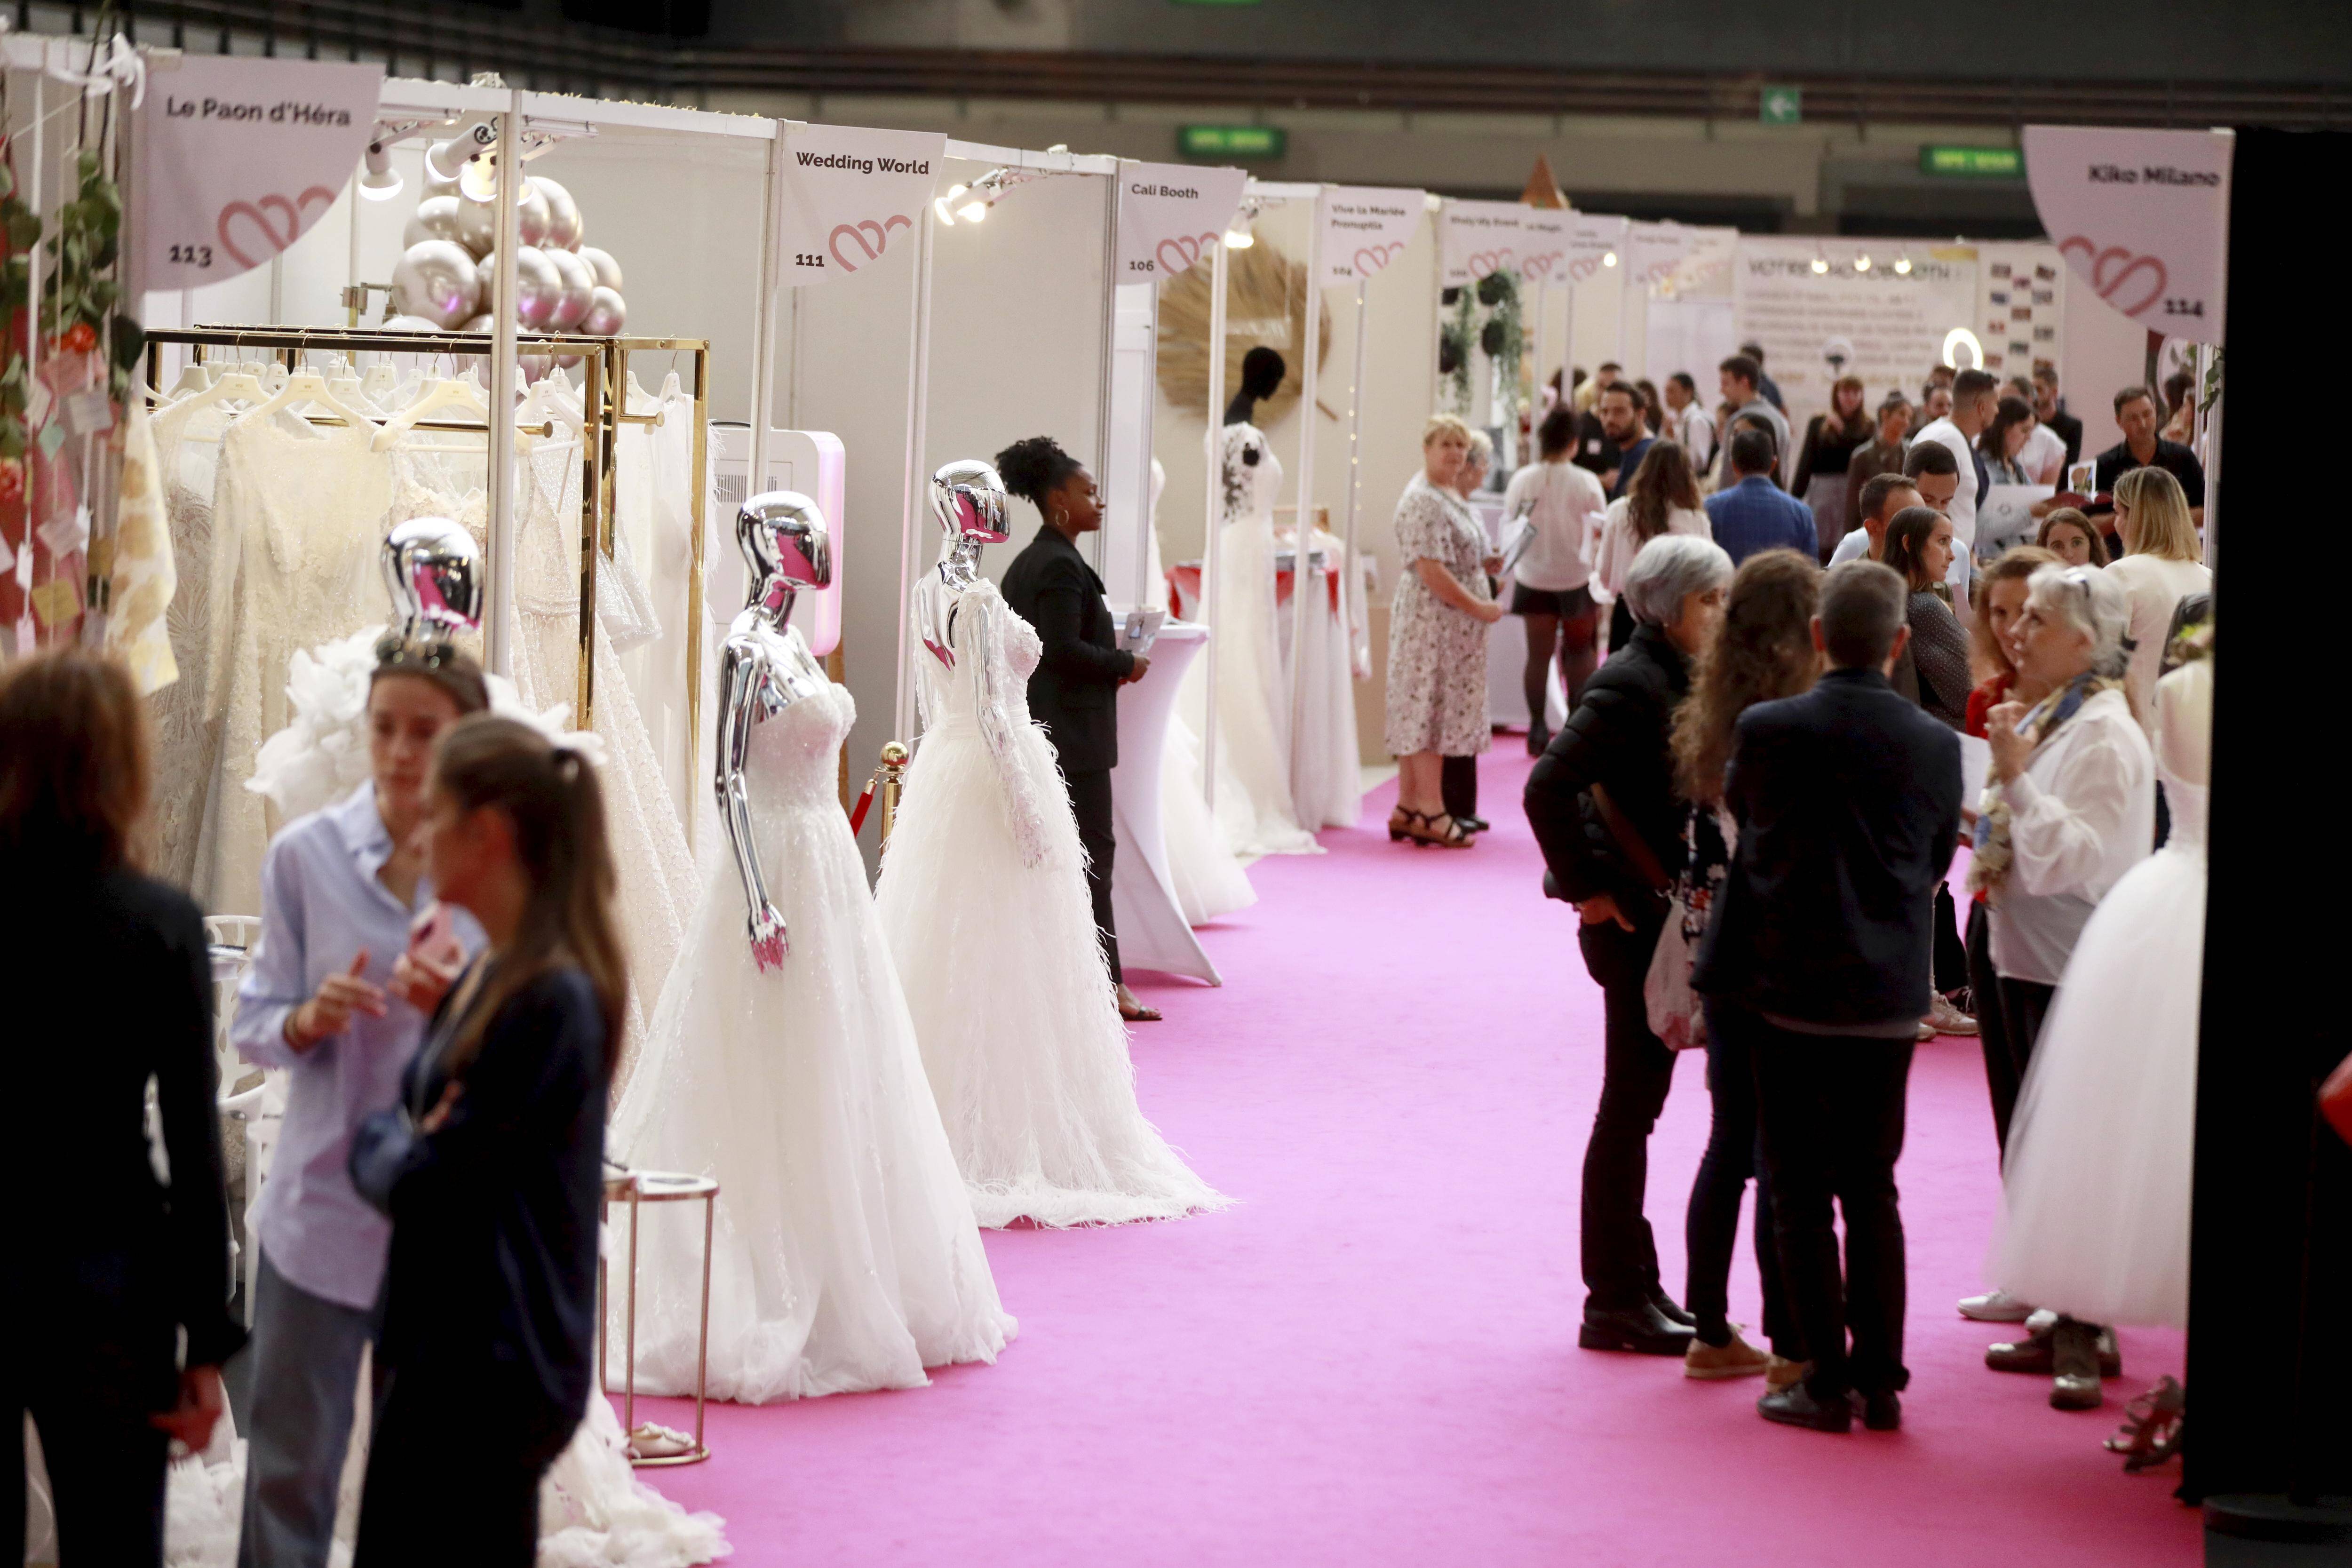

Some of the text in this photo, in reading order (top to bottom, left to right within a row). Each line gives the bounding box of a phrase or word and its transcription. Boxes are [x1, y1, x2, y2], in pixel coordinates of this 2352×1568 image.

[167, 96, 351, 126] Le Paon d'Héra
[796, 152, 929, 175] Wedding World
[2089, 165, 2220, 187] Kiko Milano
[1131, 183, 1198, 199] Cali Booth
[169, 244, 212, 268] 113
[796, 254, 824, 267] 111
[1130, 260, 1154, 271] 106
[2165, 299, 2204, 318] 114
